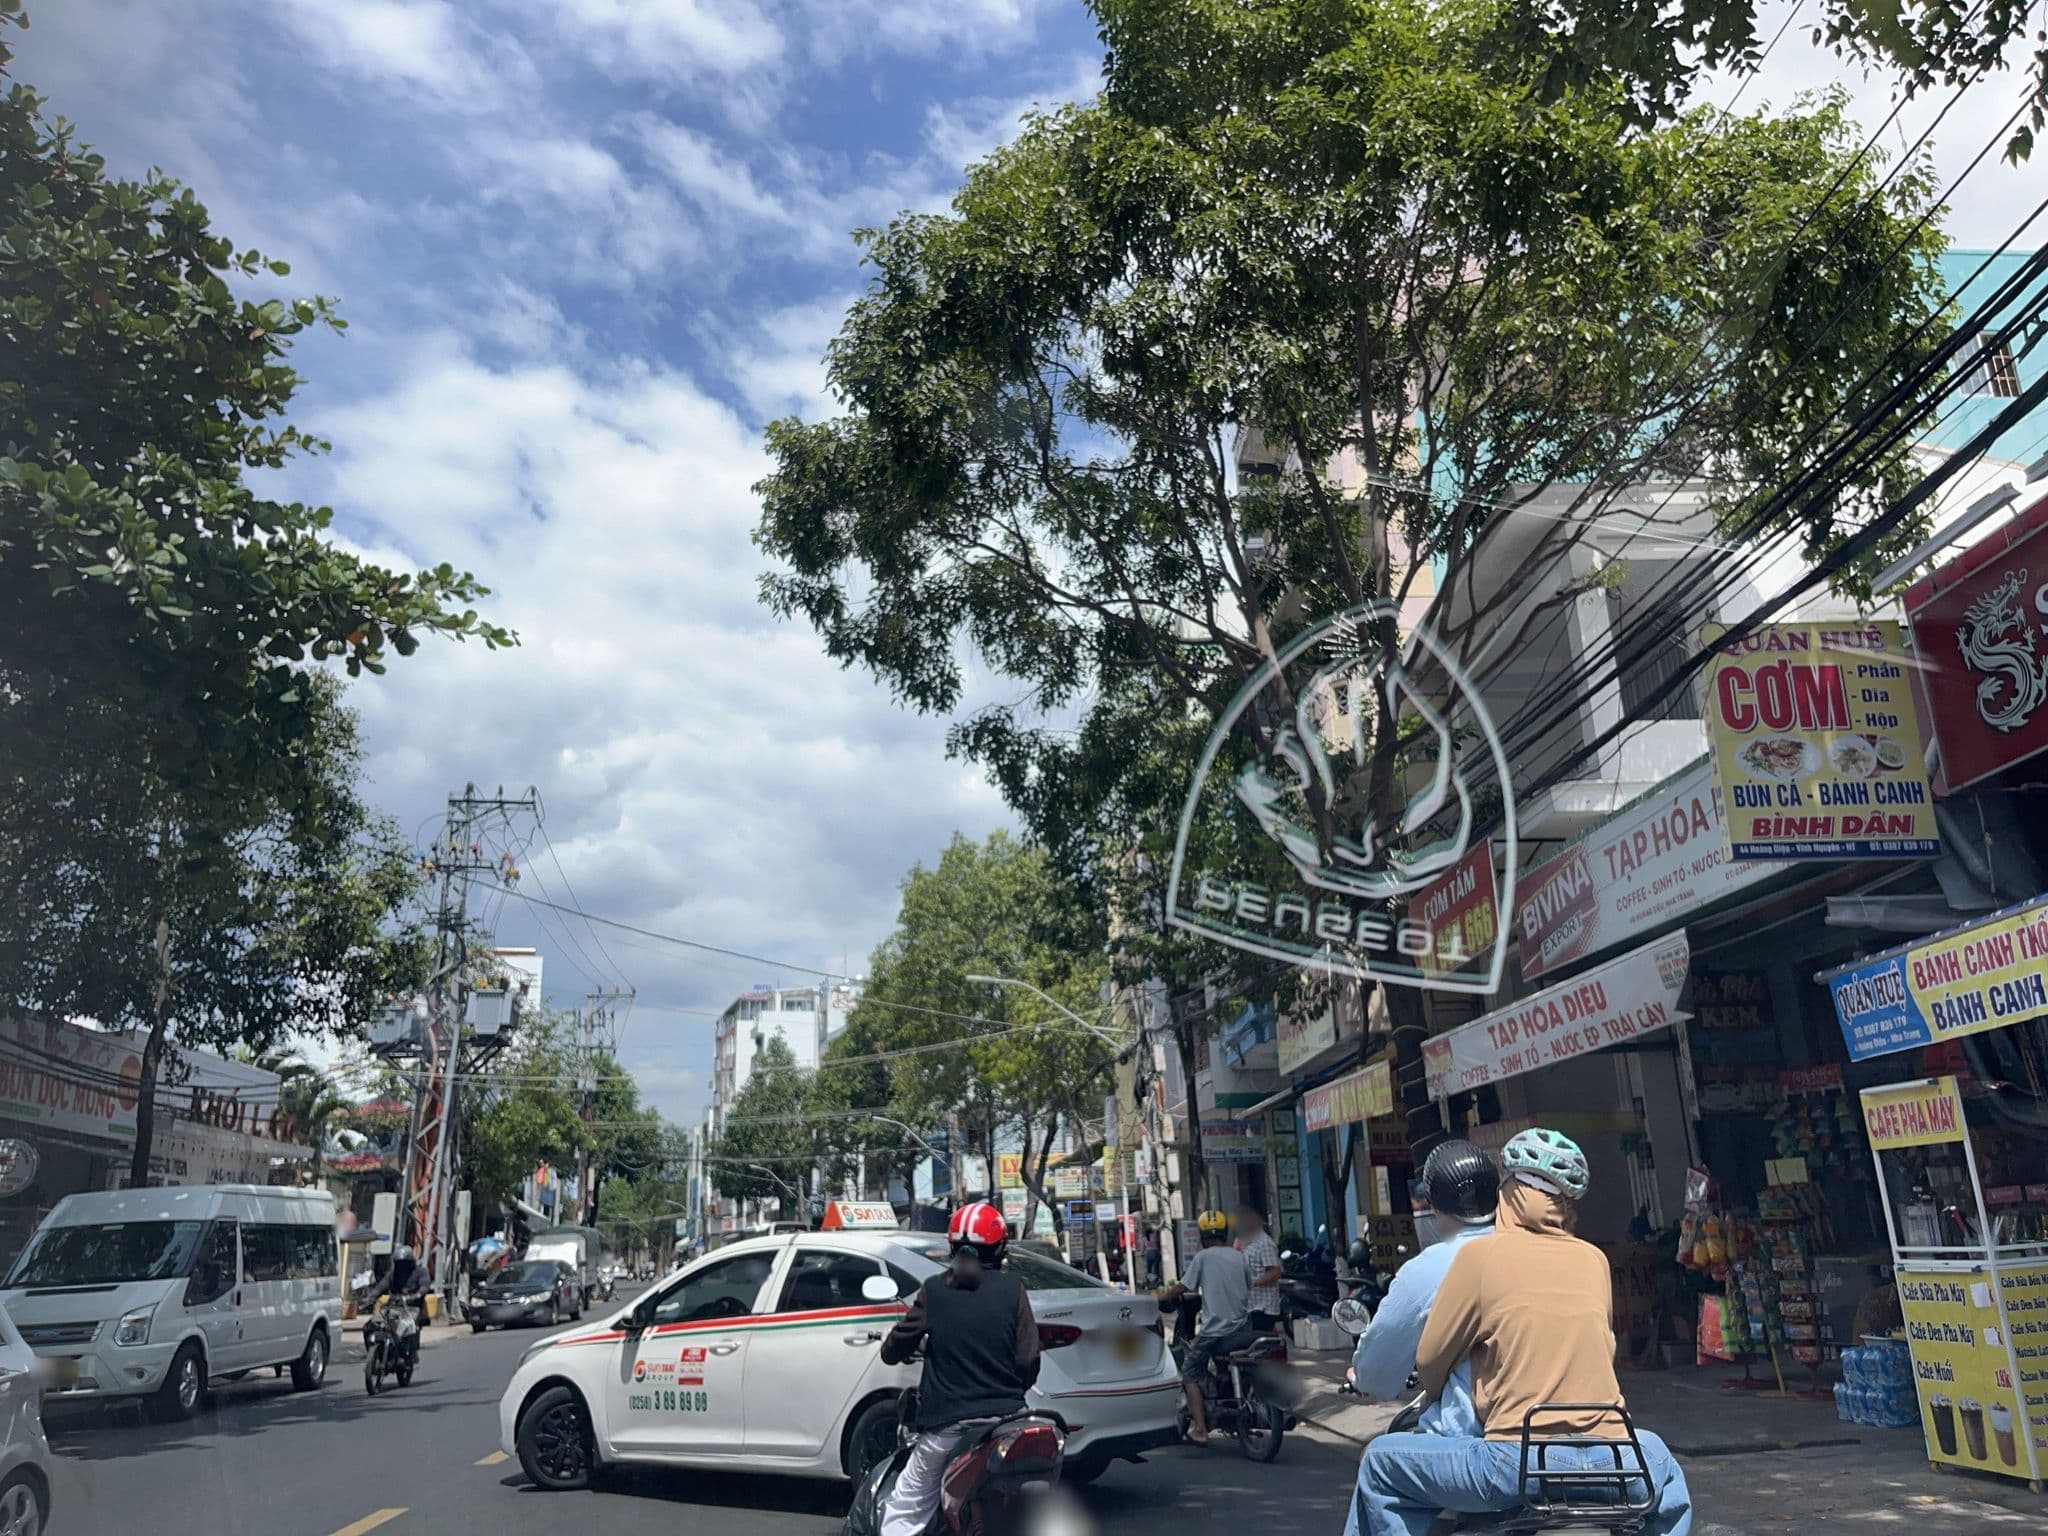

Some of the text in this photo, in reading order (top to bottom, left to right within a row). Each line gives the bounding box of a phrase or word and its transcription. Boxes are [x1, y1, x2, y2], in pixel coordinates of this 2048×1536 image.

[1717, 659, 1852, 731] CƠM
[1865, 711, 1899, 730] Hộp
[1733, 779, 1772, 809] BÚN
[1777, 779, 1802, 807] CÁ
[1818, 778, 1870, 806] BÁNH
[1874, 780, 1925, 805] CANH
[1604, 830, 1648, 883] TẠP
[1651, 797, 1710, 857] HÓA
[1752, 809, 1915, 839] BÌNH DÂN
[1521, 855, 1592, 941] BIVINA
[1615, 886, 1648, 912] COFFEE
[1652, 878, 1673, 897] SINH
[1541, 911, 1584, 962] EXPORT
[1913, 952, 1963, 991] BÁNH
[1964, 932, 2016, 977] CANH
[1837, 961, 1906, 1024] QUÁN HUỆ
[1932, 973, 2047, 1031] BÁNH CANH
[1461, 1063, 1490, 1088] COFFEE
[1501, 1052, 1524, 1076] SINH
[1583, 1023, 1600, 1047] ÉP
[1602, 1013, 1634, 1040] TRÁI
[1868, 1103, 1900, 1138] CAFE
[1902, 1099, 1927, 1134] PHA
[1902, 1282, 1920, 1301] Cafe
[1933, 1283, 1950, 1302] Pha
[1949, 1283, 1966, 1306] Máy
[2001, 1277, 2015, 1289] Cafe
[1910, 1321, 1927, 1341] Cafe
[1943, 1323, 1958, 1343] Pha
[1957, 1323, 1975, 1347] Máy
[1917, 1360, 1934, 1380] Cafe
[654, 1390, 661, 1411] 3
